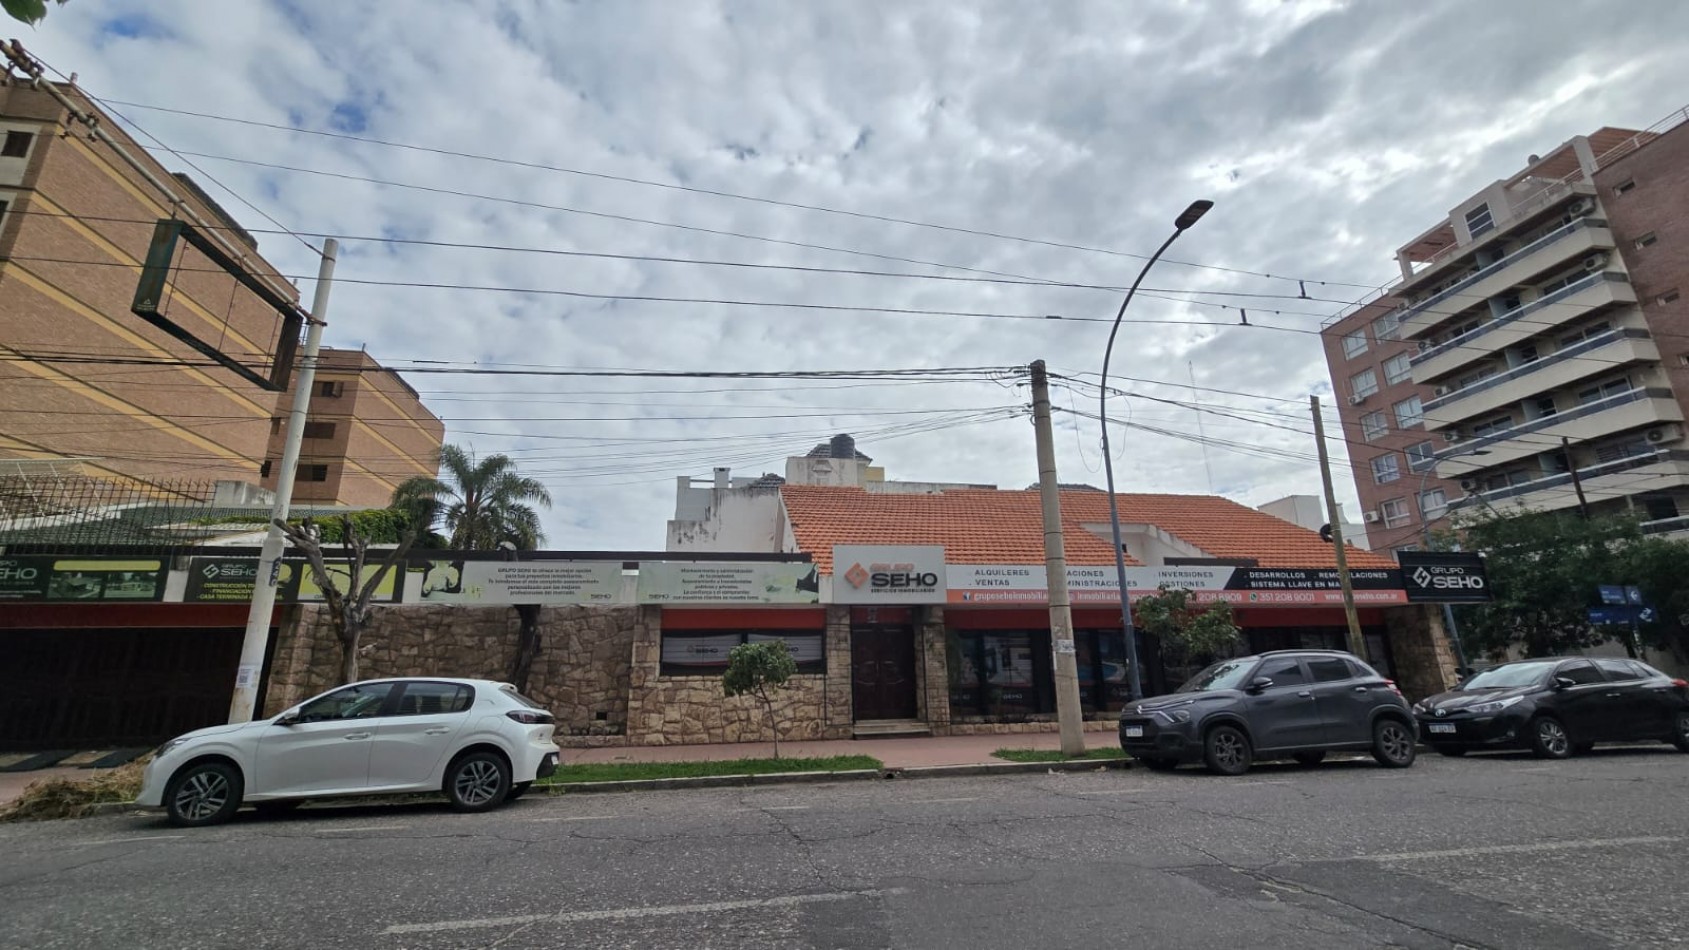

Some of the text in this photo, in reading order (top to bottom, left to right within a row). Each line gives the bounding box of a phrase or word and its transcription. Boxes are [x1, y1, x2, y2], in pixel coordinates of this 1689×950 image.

[220, 568, 258, 576] SEHO
[1430, 566, 1464, 574] GRUPO
[1249, 571, 1306, 579] DESARROLLOS
[871, 572, 938, 588] SEHO
[1432, 576, 1484, 589] SEHO
[1260, 593, 1274, 601] 351
[1275, 593, 1293, 601] 208
